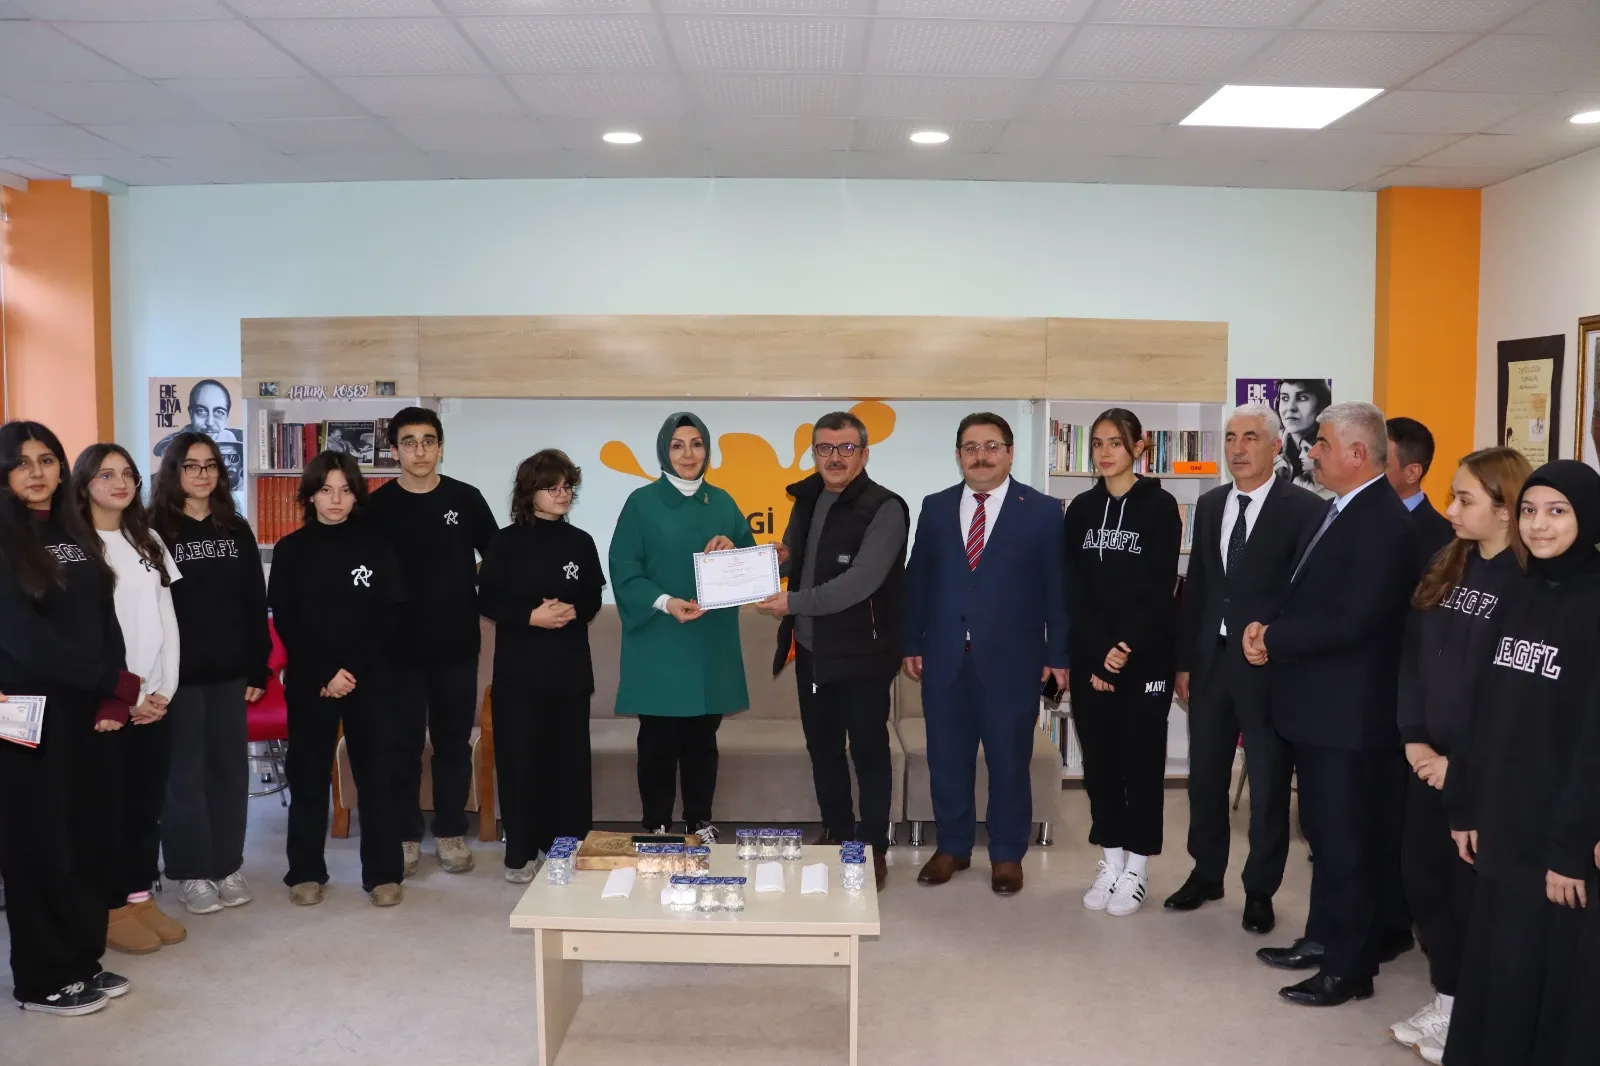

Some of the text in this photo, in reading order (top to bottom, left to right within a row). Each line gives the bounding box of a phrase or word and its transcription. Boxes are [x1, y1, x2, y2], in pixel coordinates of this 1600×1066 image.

[160, 384, 177, 399] EDE
[1247, 383, 1267, 400] EDE
[1082, 528, 1142, 555] AEGFL
[1492, 636, 1562, 680] EGFL
